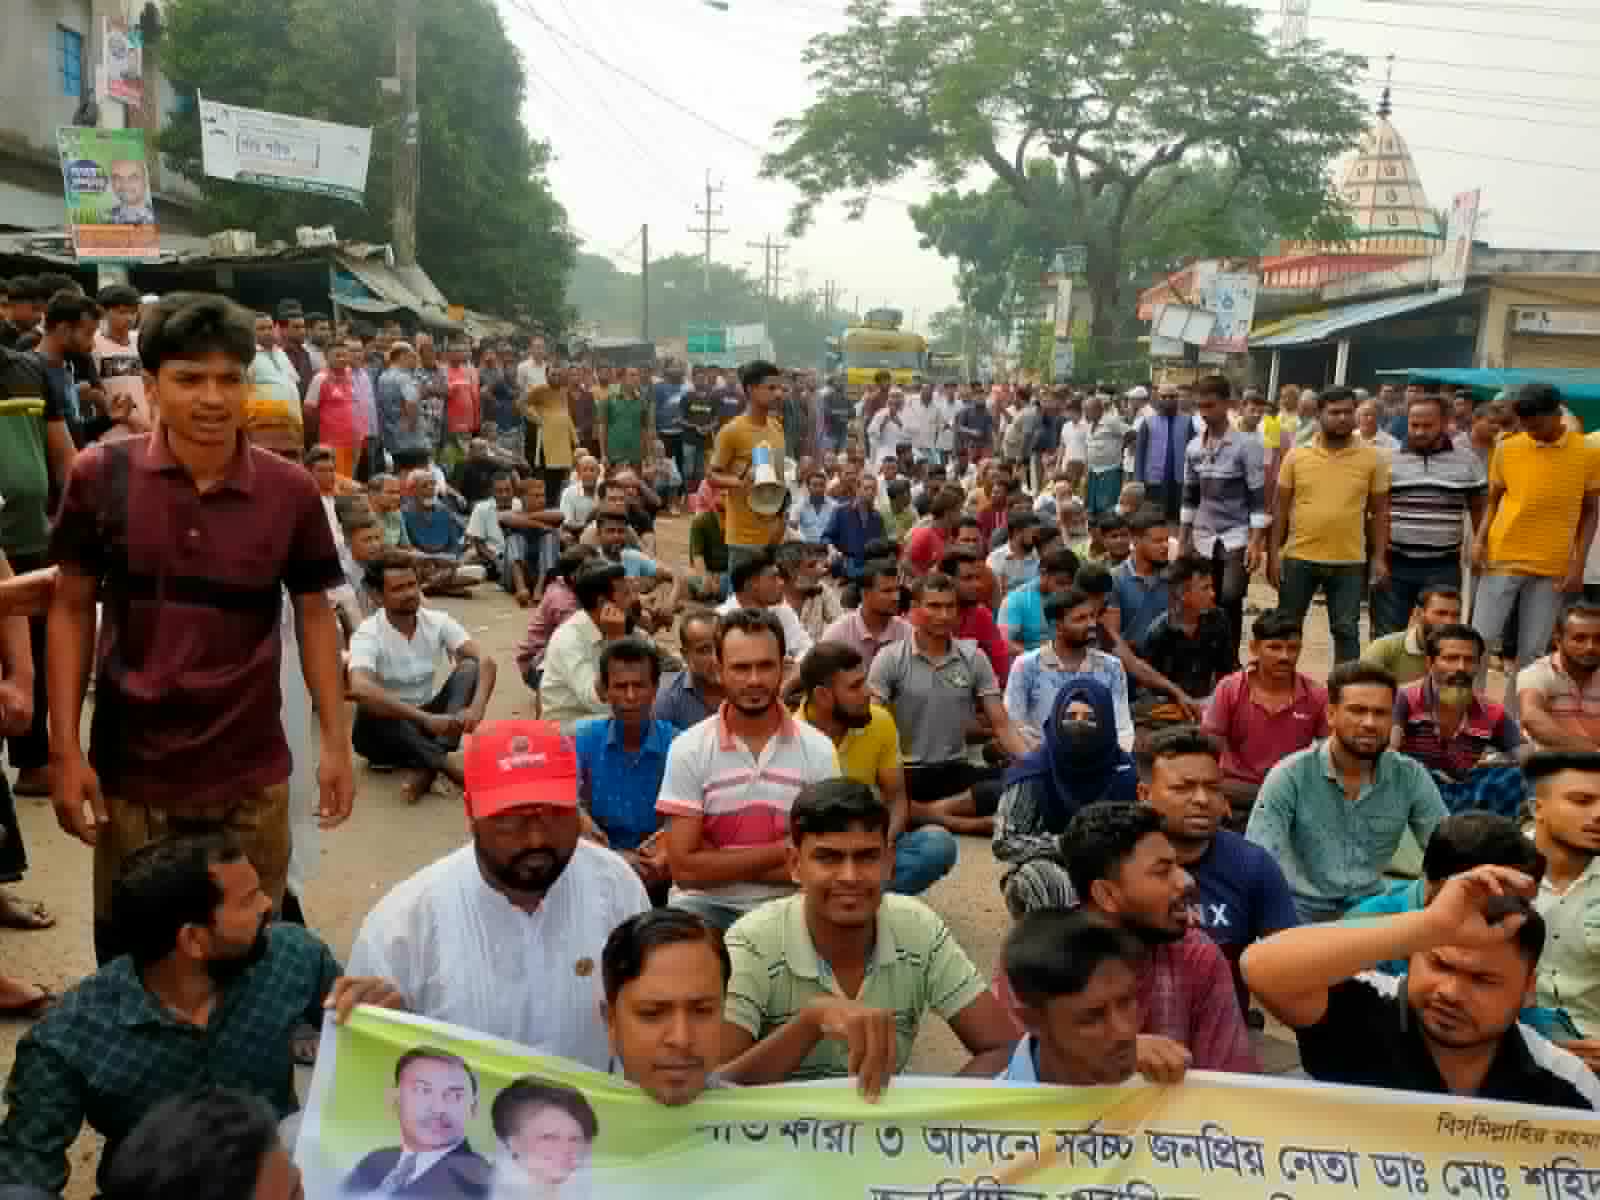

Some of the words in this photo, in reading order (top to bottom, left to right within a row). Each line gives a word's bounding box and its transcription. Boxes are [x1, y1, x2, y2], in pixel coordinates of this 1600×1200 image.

[875, 1121, 904, 1157] ৩
[920, 1121, 1040, 1167] আসনে
[1144, 1121, 1264, 1178] জনপ্রিয়
[1279, 1142, 1361, 1190] নেতা
[1368, 1151, 1429, 1194] ডাঃ
[1442, 1157, 1511, 1200] মোঃ
